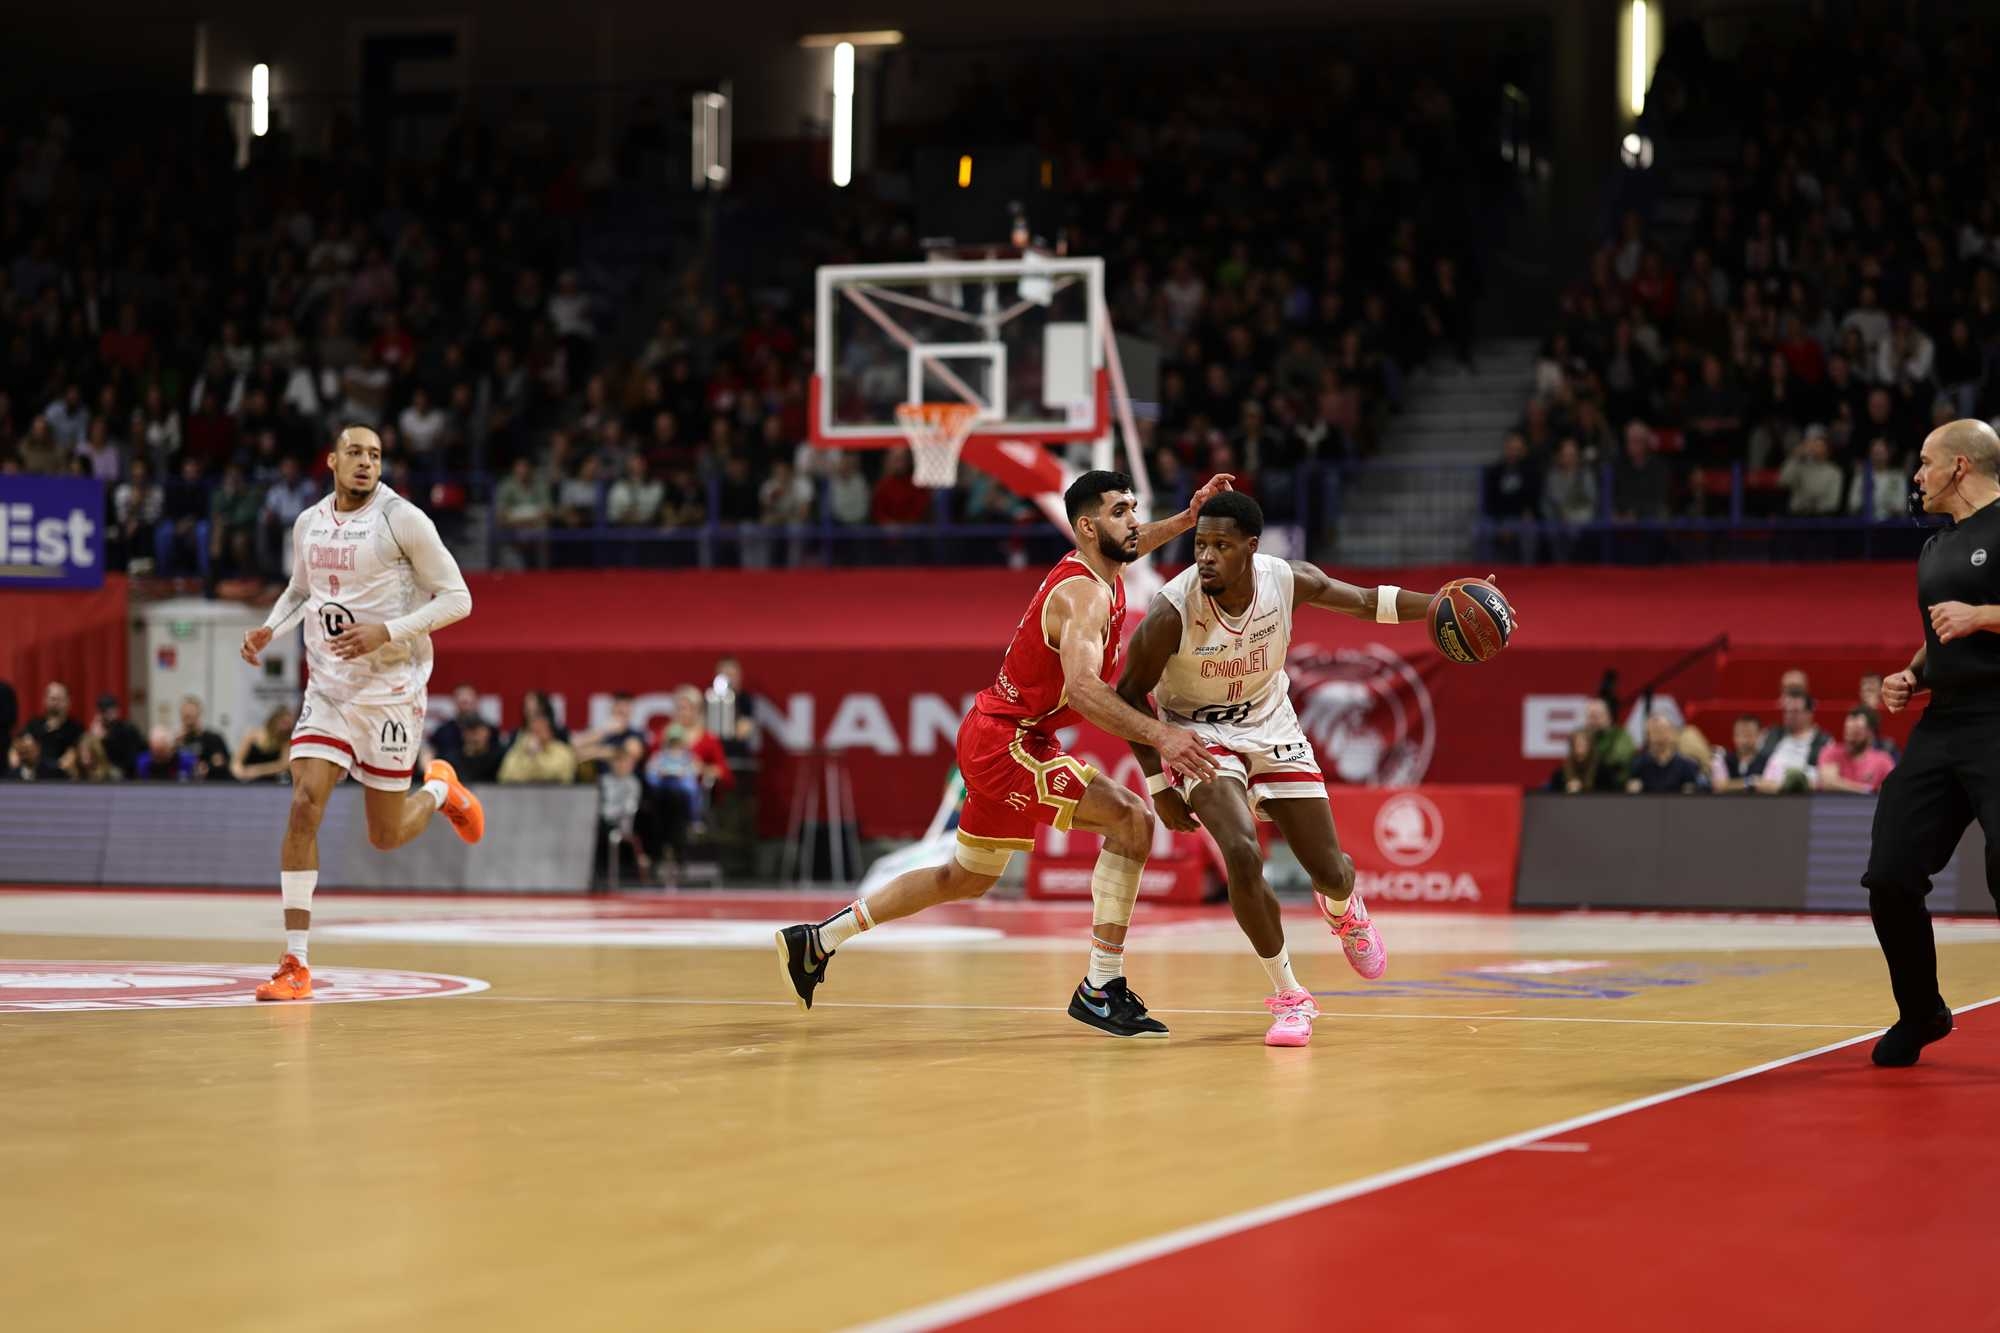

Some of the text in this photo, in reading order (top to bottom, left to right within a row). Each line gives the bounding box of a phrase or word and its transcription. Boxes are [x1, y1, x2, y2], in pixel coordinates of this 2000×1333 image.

[309, 544, 357, 571] CHOLET
[1201, 643, 1269, 679] CHOLET
[1227, 680, 1243, 702] 11
[751, 693, 984, 755] NAN
[1052, 772, 1071, 794] NCY
